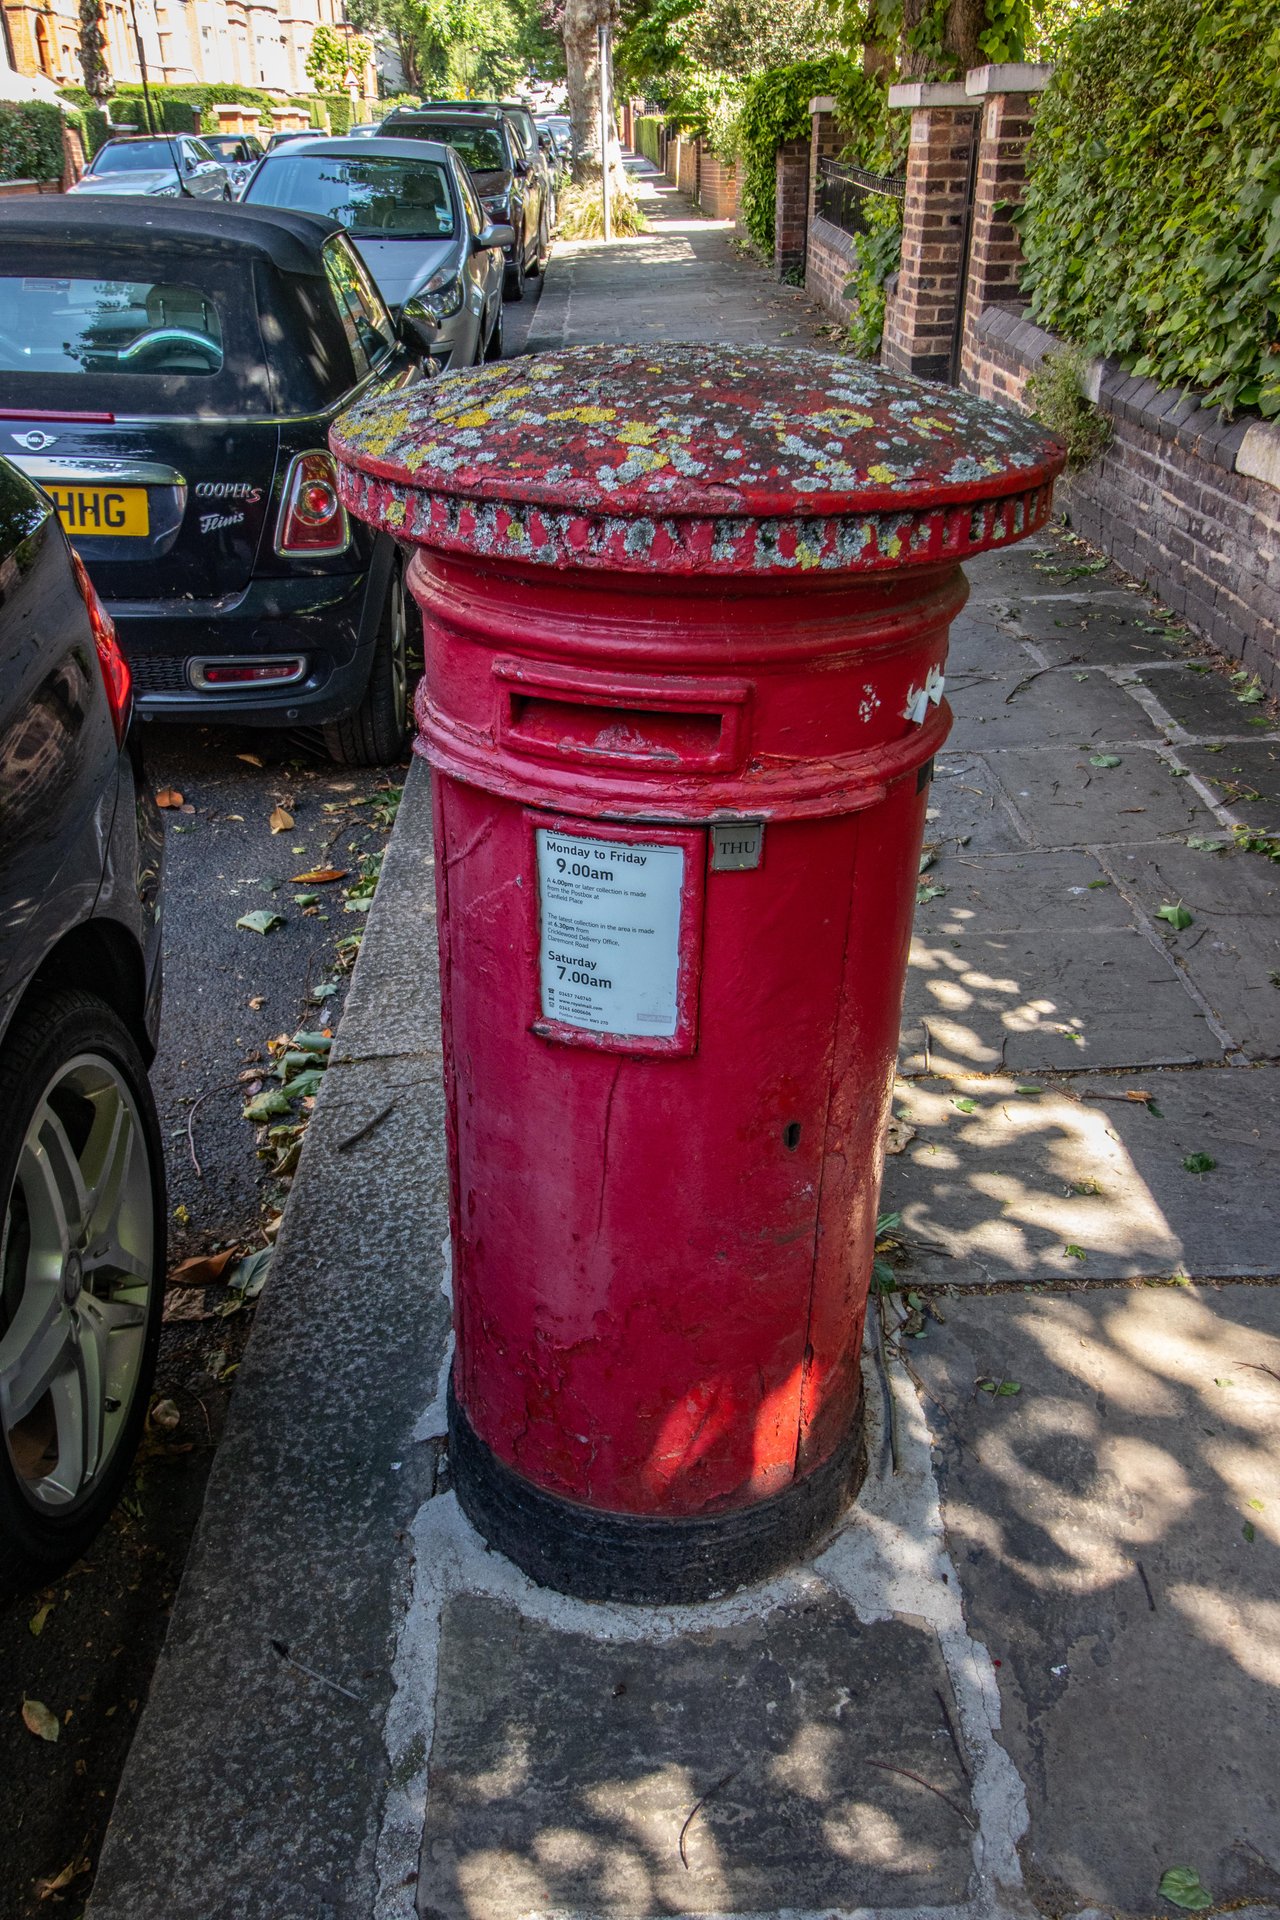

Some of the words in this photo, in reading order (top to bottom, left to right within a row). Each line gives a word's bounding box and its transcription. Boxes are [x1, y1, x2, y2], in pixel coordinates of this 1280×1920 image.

[195, 482, 252, 498] COOPER
[246, 487, 263, 503] S
[52, 491, 126, 528] HHG
[200, 511, 245, 534] Flims
[546, 841, 590, 859] Monday
[594, 850, 605, 860] to
[610, 851, 647, 866] Friday
[720, 841, 756, 855] THU
[556, 858, 614, 881] 9.00am
[546, 885, 560, 893] from
[571, 889, 592, 899] Postbox
[552, 878, 574, 888] 4.00pm
[582, 884, 594, 892] later
[596, 886, 622, 895] collection
[630, 890, 646, 898] made
[547, 892, 568, 902] Canfield
[569, 896, 583, 905] Place
[548, 912, 557, 920] The
[558, 915, 573, 923] latest
[574, 918, 599, 928] collection
[554, 921, 575, 932] 6.30pm
[576, 926, 589, 934] from
[547, 927, 578, 940] Cricklewood
[579, 935, 601, 945] Delivery
[602, 938, 620, 947] Office,
[547, 935, 574, 946] Claremont
[575, 940, 589, 949] Road
[548, 950, 597, 970] Saturday
[557, 965, 612, 989] 7.00am
